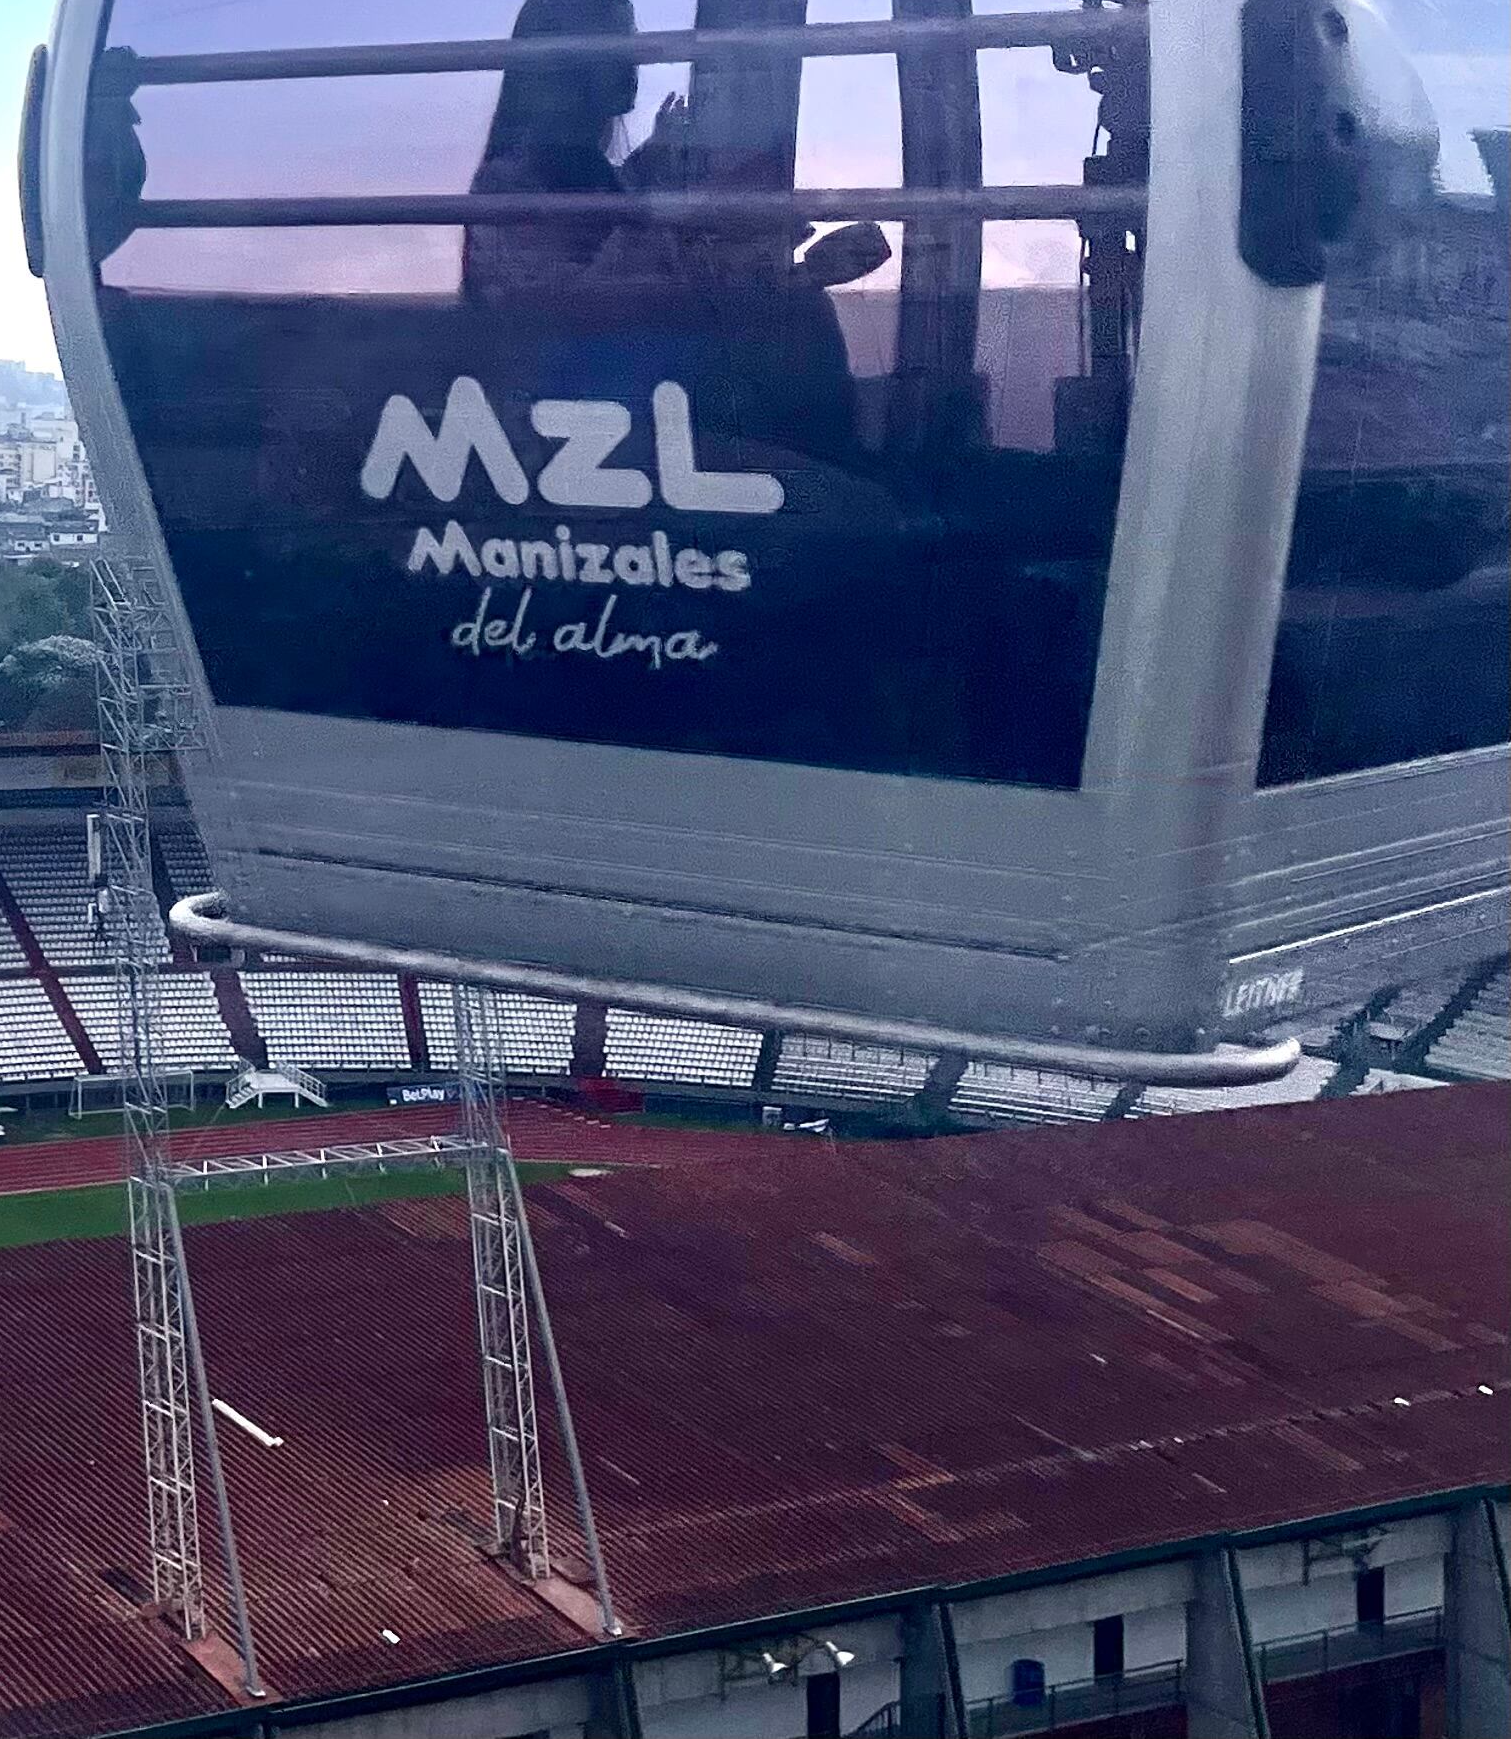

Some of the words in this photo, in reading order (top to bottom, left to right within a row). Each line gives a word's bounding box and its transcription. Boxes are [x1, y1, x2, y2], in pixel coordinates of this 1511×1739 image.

[361, 376, 785, 513] MZL
[407, 520, 752, 591] Manizales
[451, 587, 537, 656] del
[553, 595, 719, 669] alma
